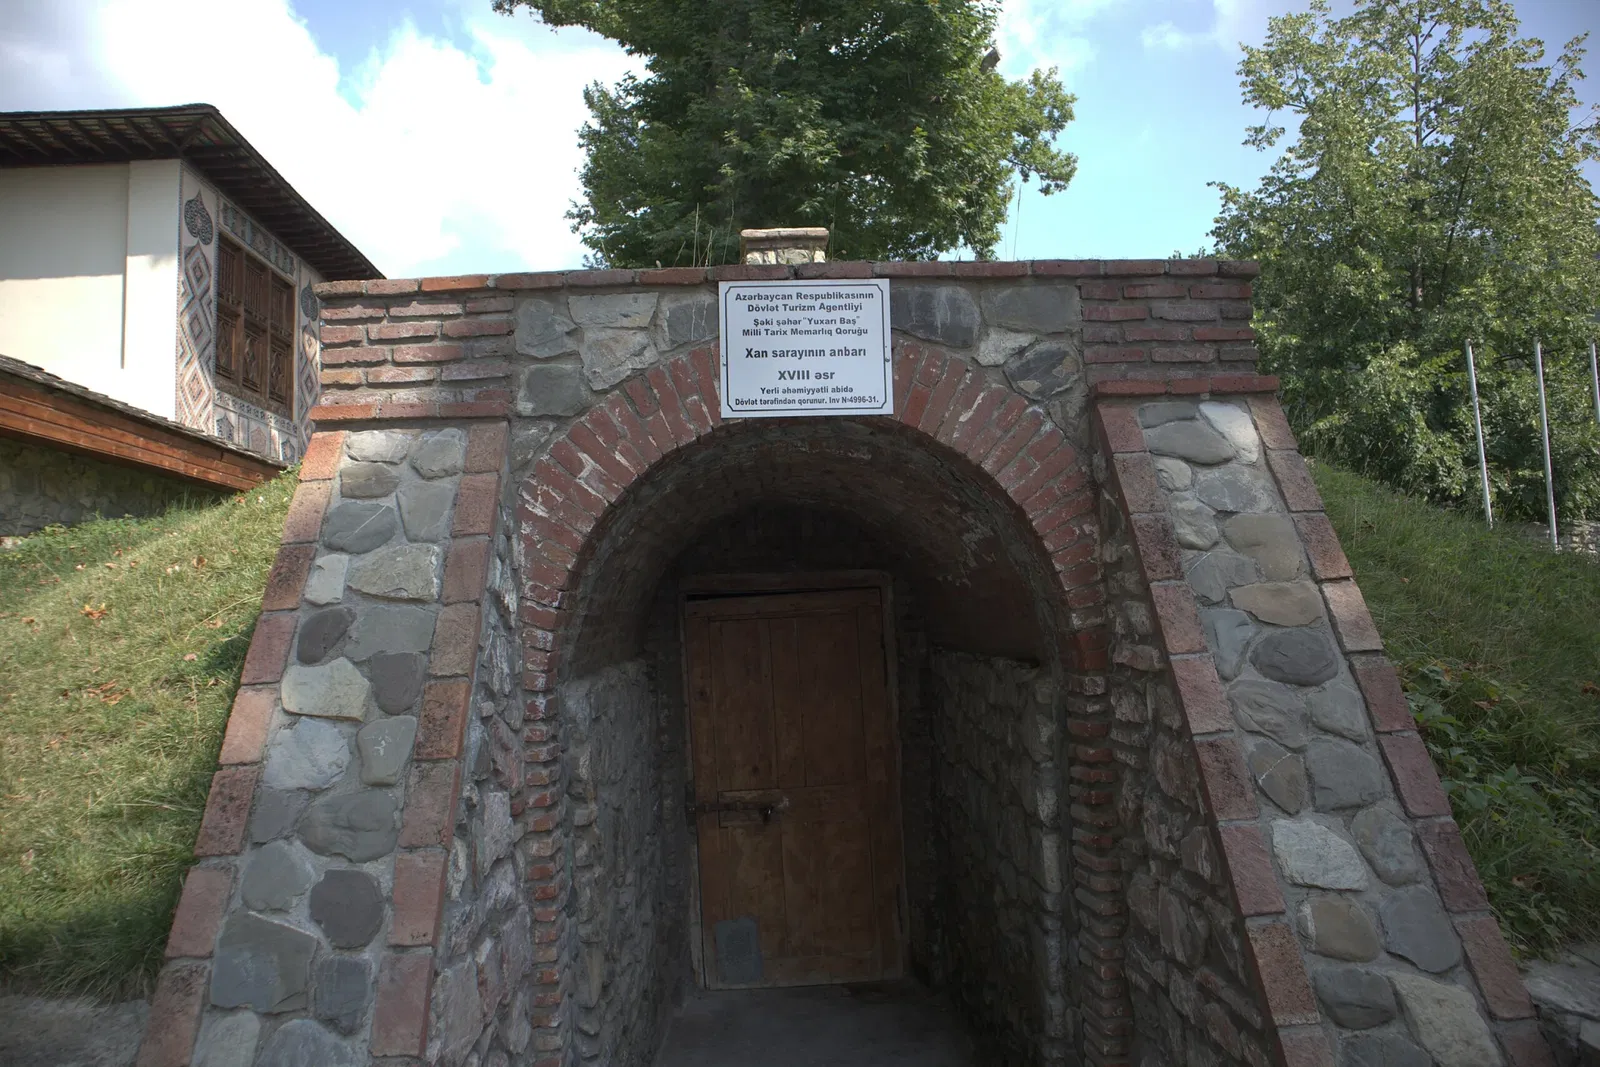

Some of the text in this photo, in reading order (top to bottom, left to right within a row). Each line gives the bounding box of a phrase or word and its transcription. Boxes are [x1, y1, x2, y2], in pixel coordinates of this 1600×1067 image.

[735, 292, 874, 302] Azərbaycan Respublikasının
[819, 303, 862, 312] Agentliyi
[754, 319, 773, 327] Şəki
[776, 318, 802, 326] şəhər
[836, 327, 868, 336] Qoruğu
[746, 347, 866, 360] Xan sarayının anbarı
[778, 370, 810, 380] XVIII
[782, 386, 828, 395] əhəmiyyətli
